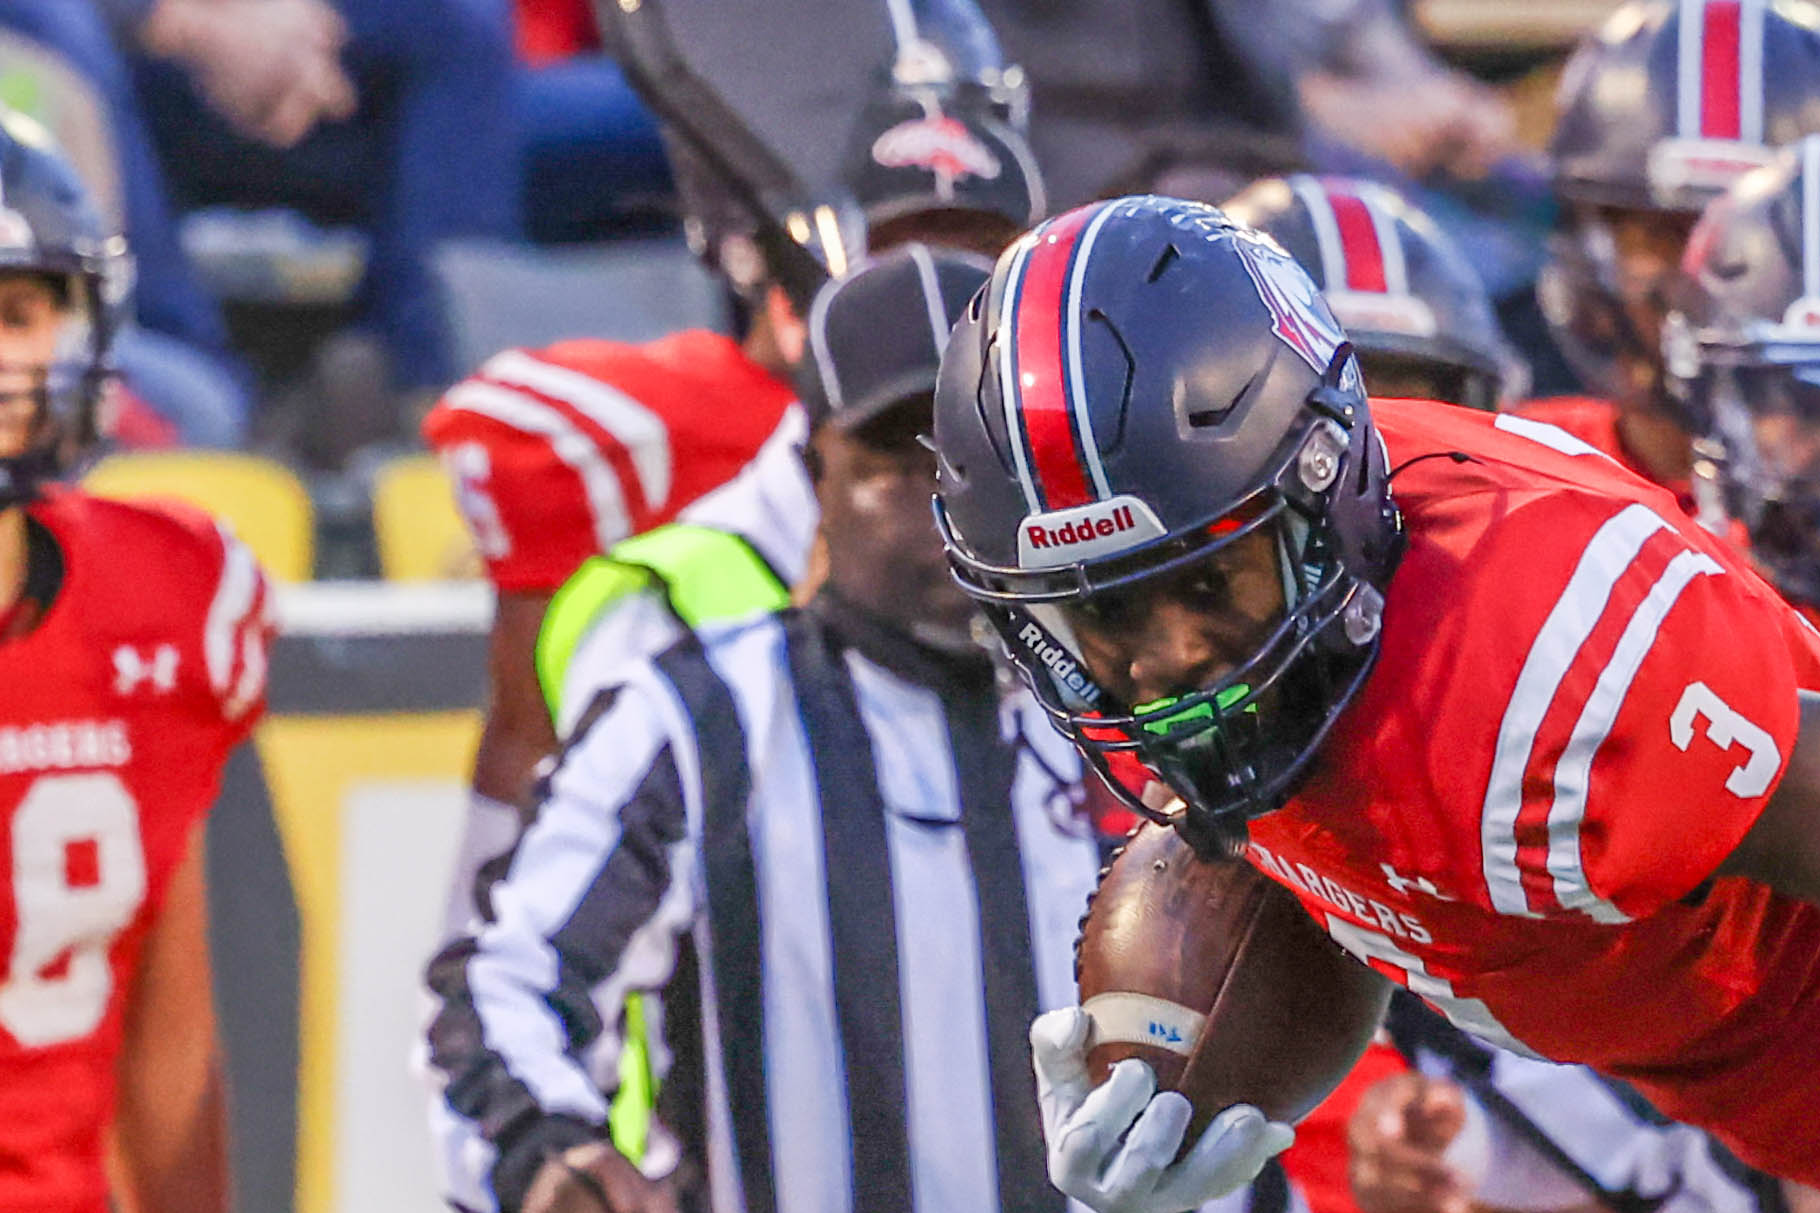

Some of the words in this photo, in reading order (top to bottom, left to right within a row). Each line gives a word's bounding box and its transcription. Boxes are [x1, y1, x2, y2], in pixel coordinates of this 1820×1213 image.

[1027, 506, 1136, 549] Riddell
[1018, 622, 1101, 703] Riddell
[1669, 680, 1782, 799] 3
